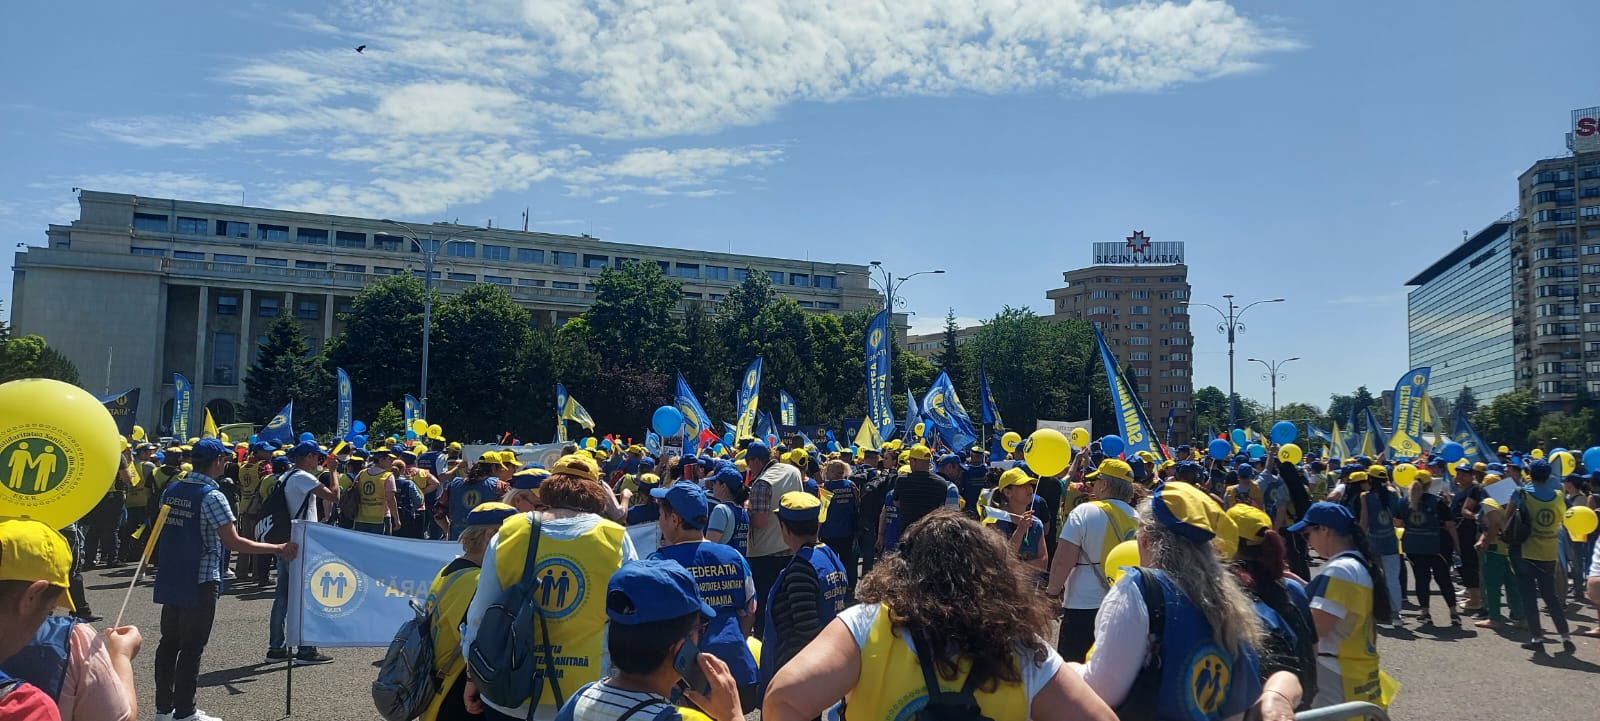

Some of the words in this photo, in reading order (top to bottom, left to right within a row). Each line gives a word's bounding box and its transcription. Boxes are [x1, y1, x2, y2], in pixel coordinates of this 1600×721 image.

[1576, 117, 1600, 137] S
[1096, 254, 1138, 264] REGINA
[1143, 253, 1182, 264] MARIA
